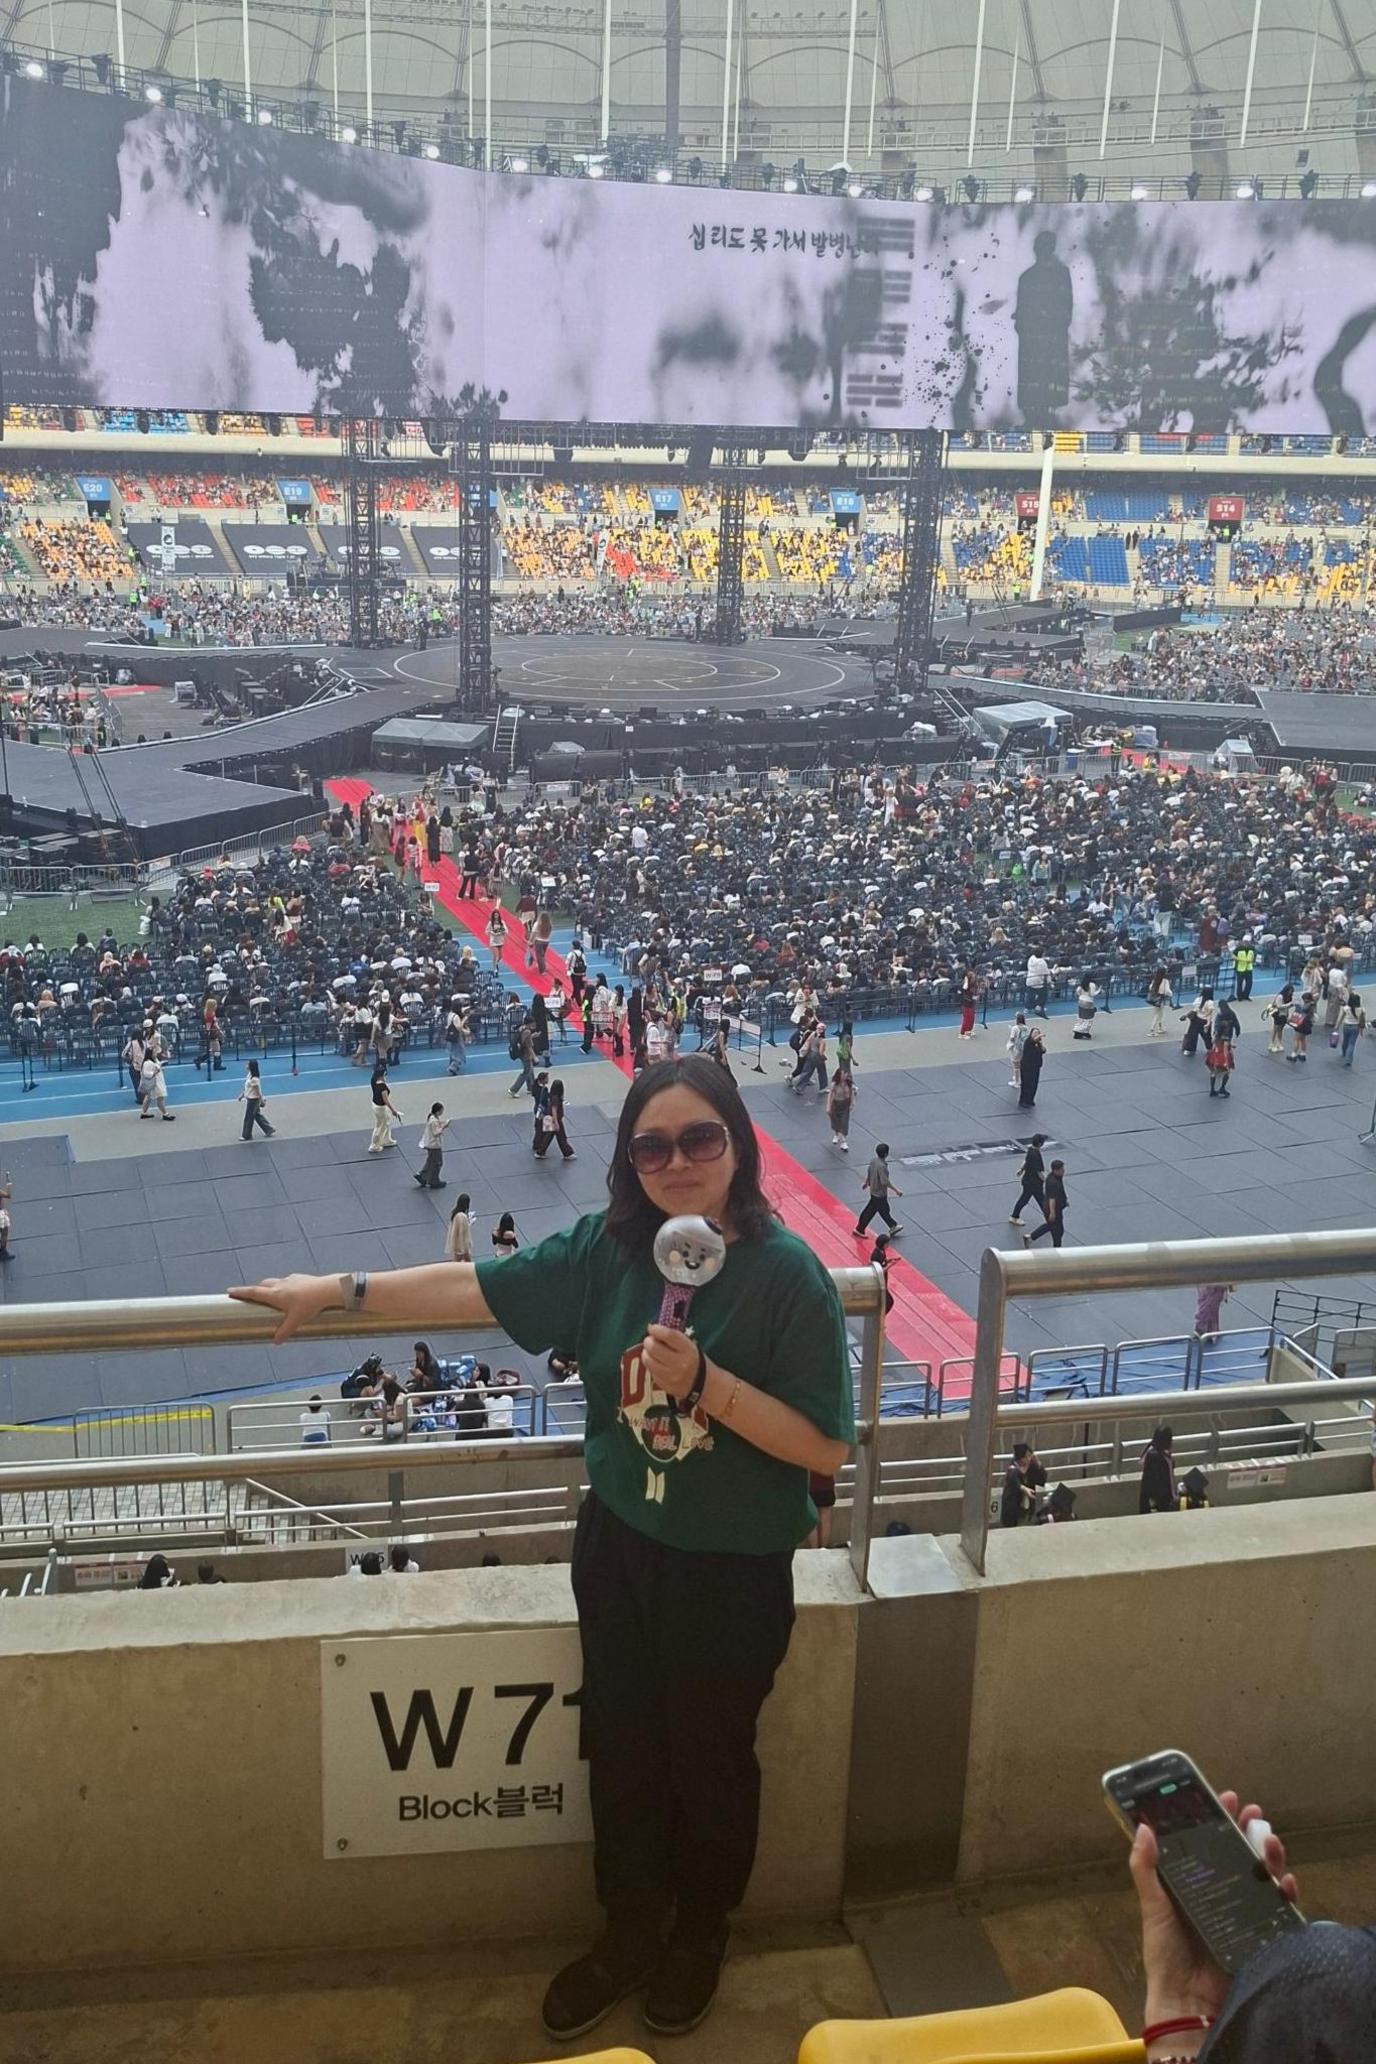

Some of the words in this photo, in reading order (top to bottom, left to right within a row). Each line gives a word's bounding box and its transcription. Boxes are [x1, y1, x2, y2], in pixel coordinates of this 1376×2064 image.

[688, 223, 706, 250] 십
[711, 225, 745, 249] 리도
[750, 227, 768, 252] 못
[773, 228, 806, 253] 가서
[83, 483, 103, 493] E20
[370, 1686, 474, 1771] W
